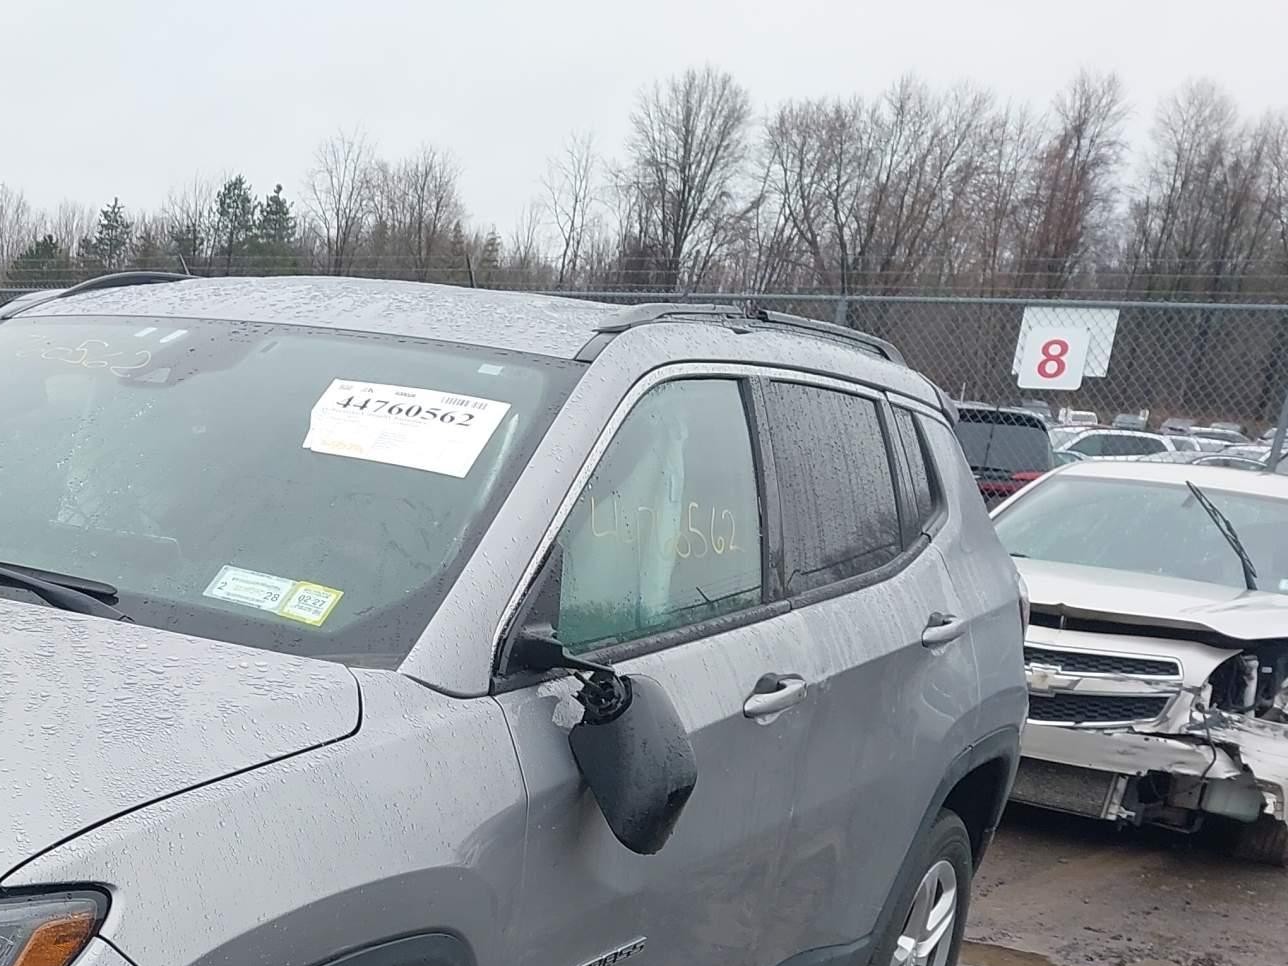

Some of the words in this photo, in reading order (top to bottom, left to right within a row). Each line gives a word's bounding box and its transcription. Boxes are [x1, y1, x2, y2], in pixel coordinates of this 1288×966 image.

[1037, 338, 1070, 379] 8
[335, 394, 476, 428] 44760562
[263, 591, 280, 602] 28
